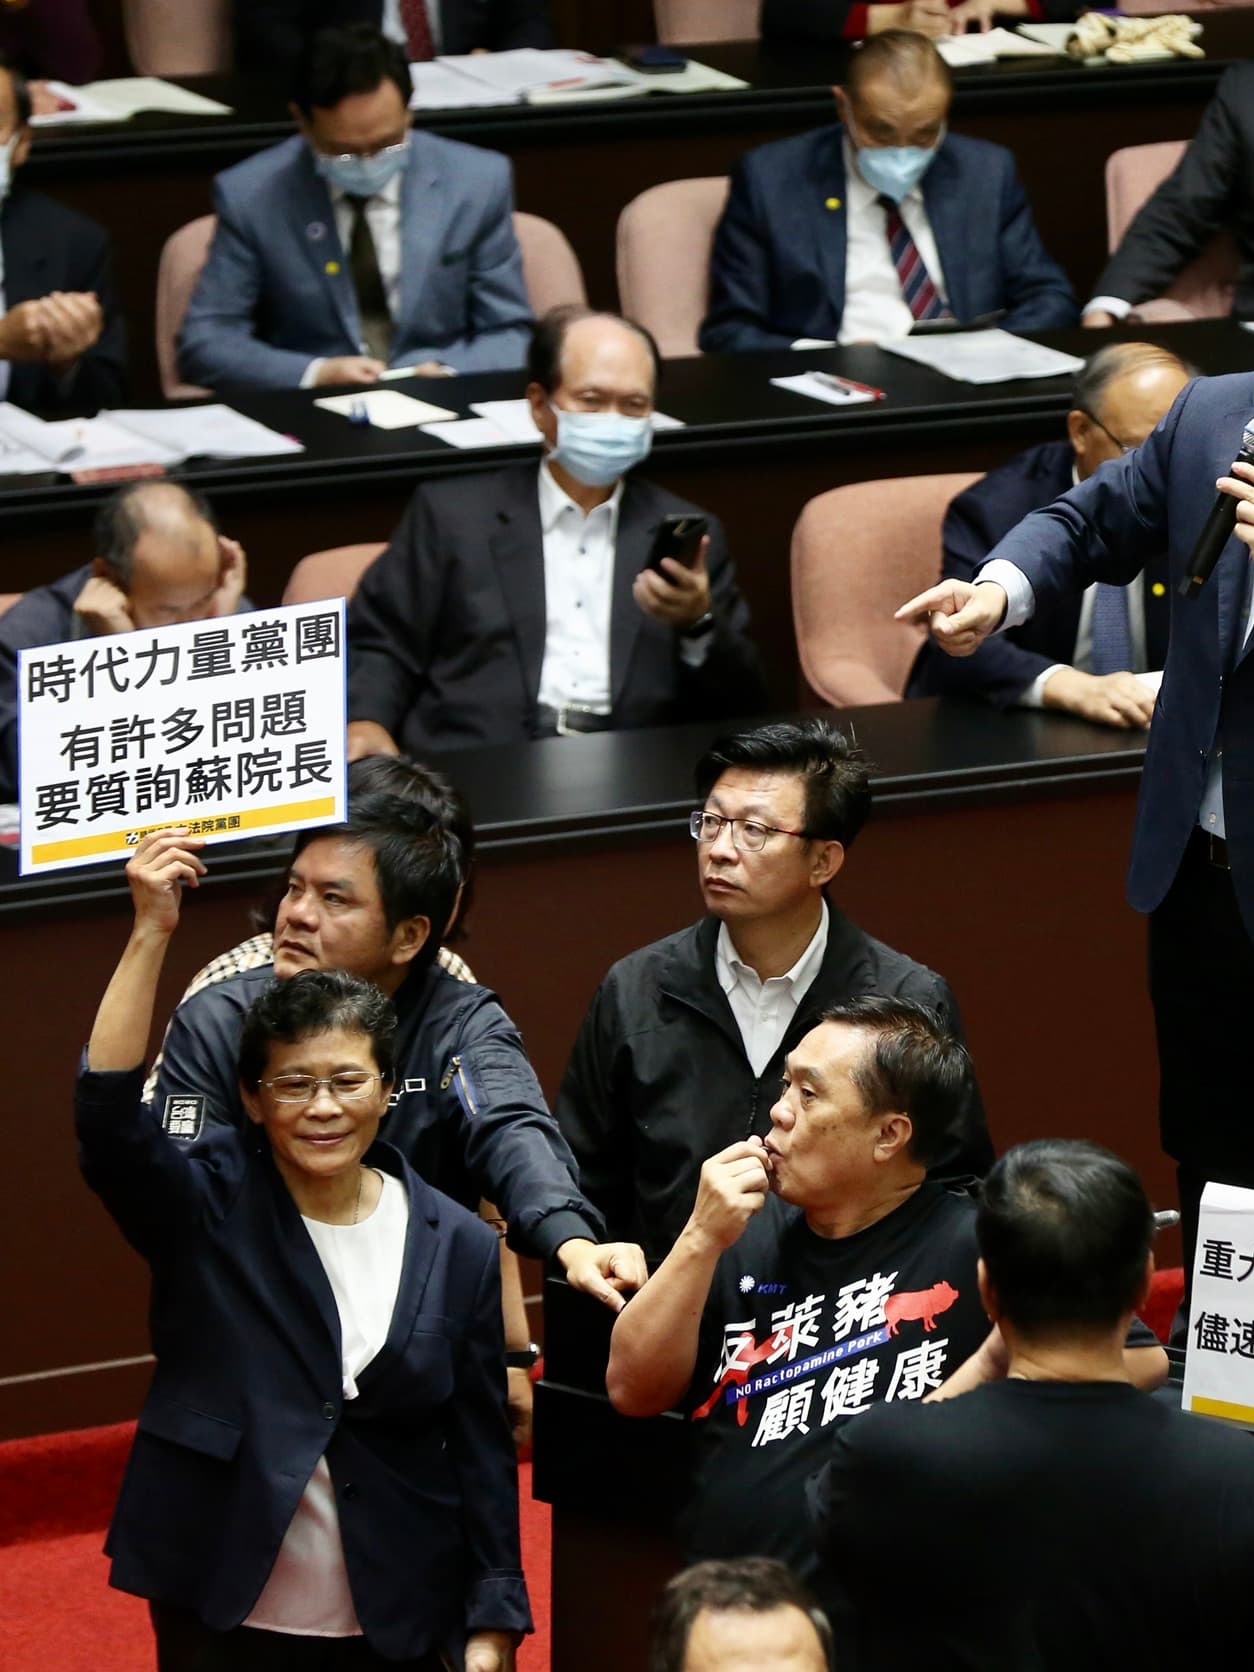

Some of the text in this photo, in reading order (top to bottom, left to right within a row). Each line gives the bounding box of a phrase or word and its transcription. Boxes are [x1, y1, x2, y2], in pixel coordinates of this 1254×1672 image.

[28, 611, 341, 703] 時代力量黨團
[60, 690, 306, 771] 有許多問題
[35, 739, 332, 830] 要質詢蘇院長
[713, 1271, 899, 1383] 反萊豬
[757, 1283, 787, 1295] KMT
[735, 1331, 883, 1399] NO Ractopamine Pork
[751, 1337, 949, 1447] 顧健康
